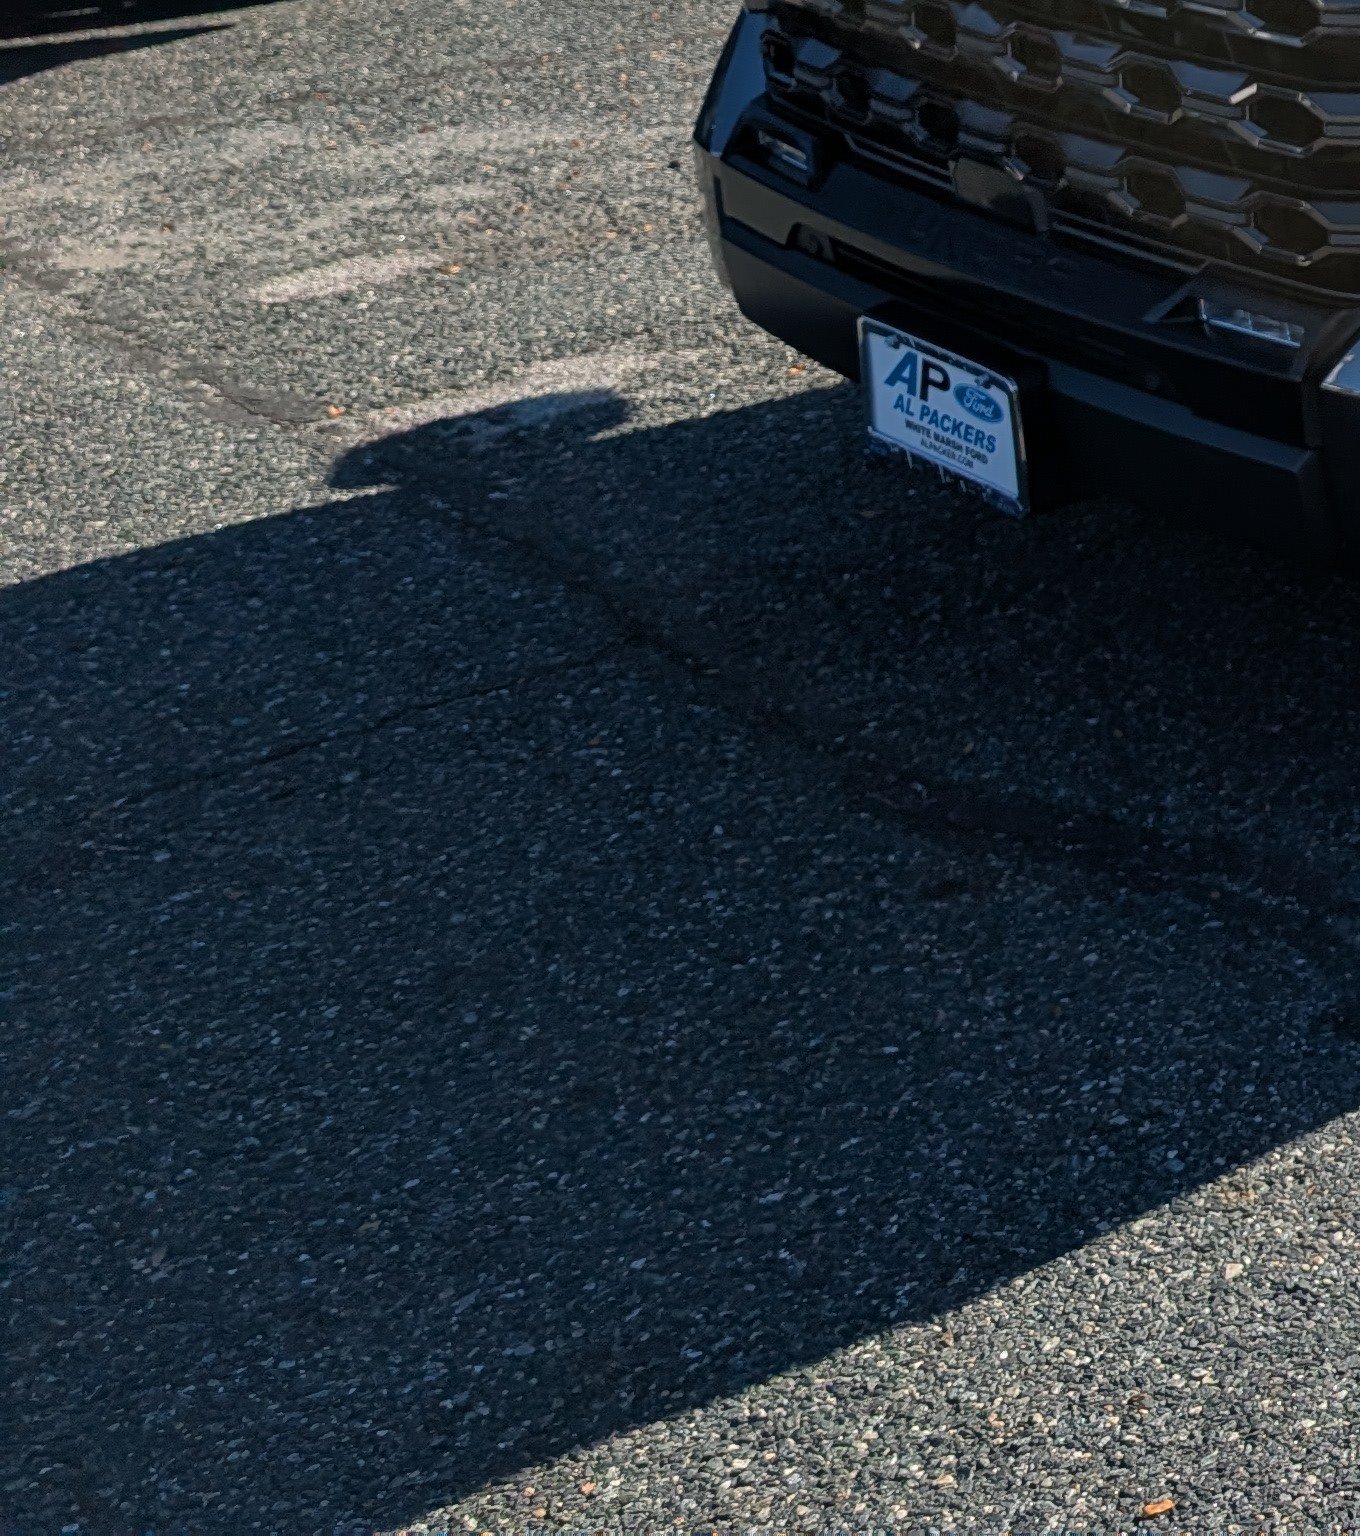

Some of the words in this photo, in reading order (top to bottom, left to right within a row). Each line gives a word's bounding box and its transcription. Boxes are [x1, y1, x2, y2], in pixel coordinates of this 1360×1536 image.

[884, 351, 950, 402] AP
[893, 394, 915, 417] AL
[919, 404, 996, 453] PACKERS
[963, 388, 995, 418] Ford
